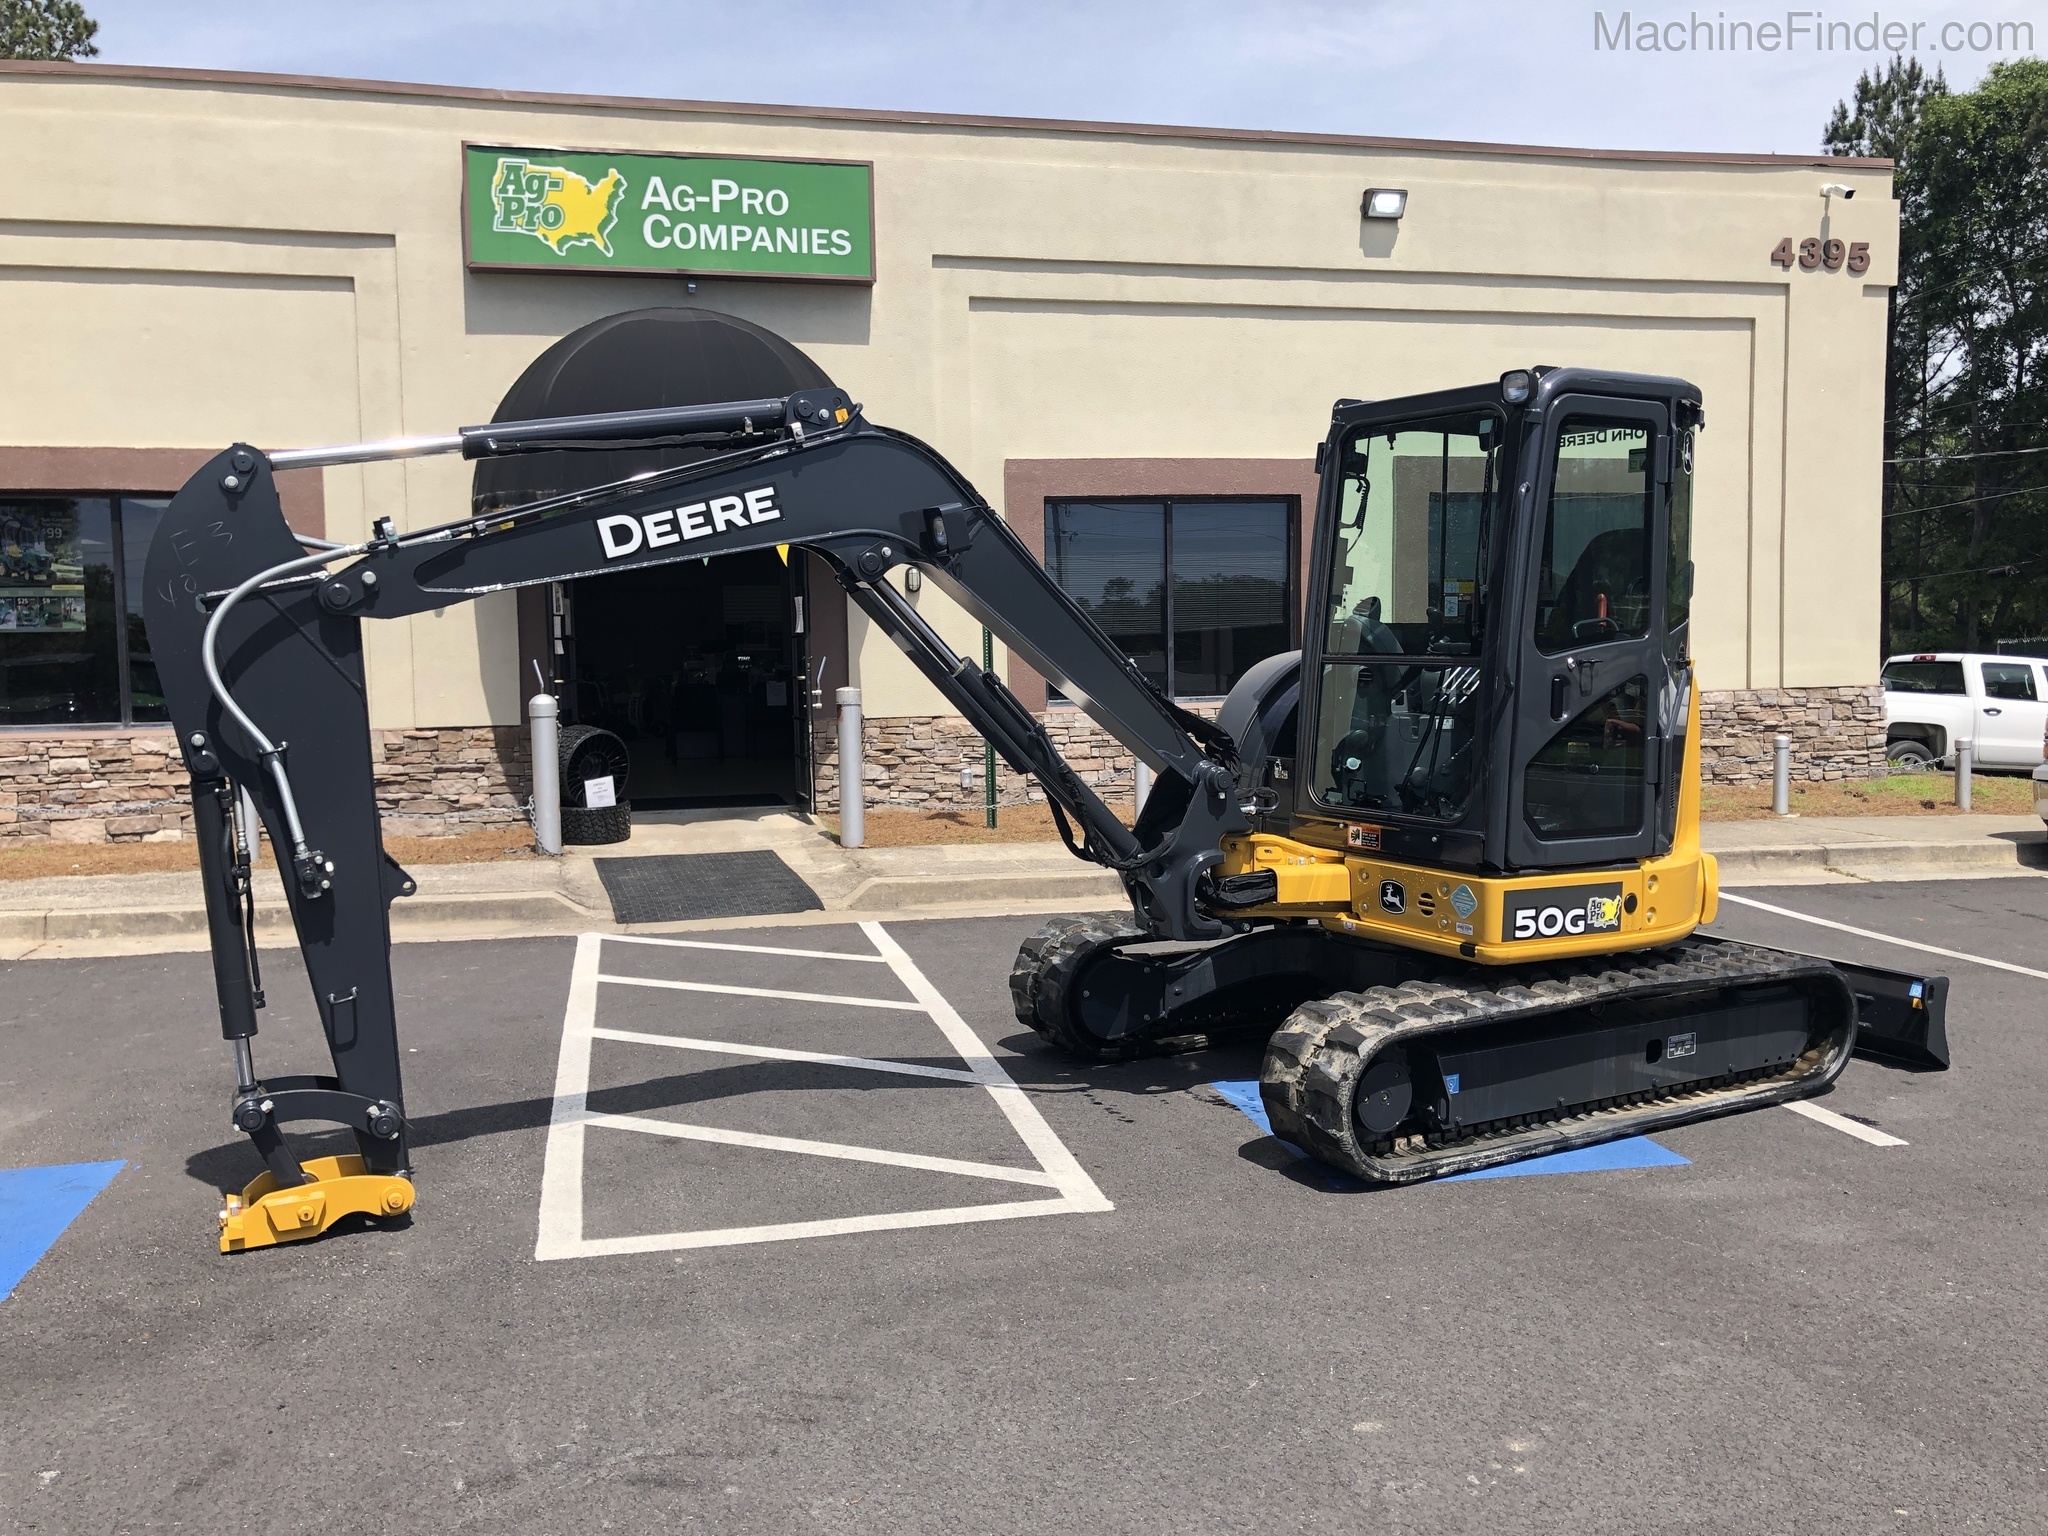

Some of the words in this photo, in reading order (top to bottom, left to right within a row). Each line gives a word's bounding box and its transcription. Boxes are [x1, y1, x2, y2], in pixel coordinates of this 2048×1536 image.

[497, 196, 565, 231] Pro
[1770, 236, 1872, 273] 4395
[596, 486, 781, 560] DEERE
[1514, 906, 1586, 939] 50G
